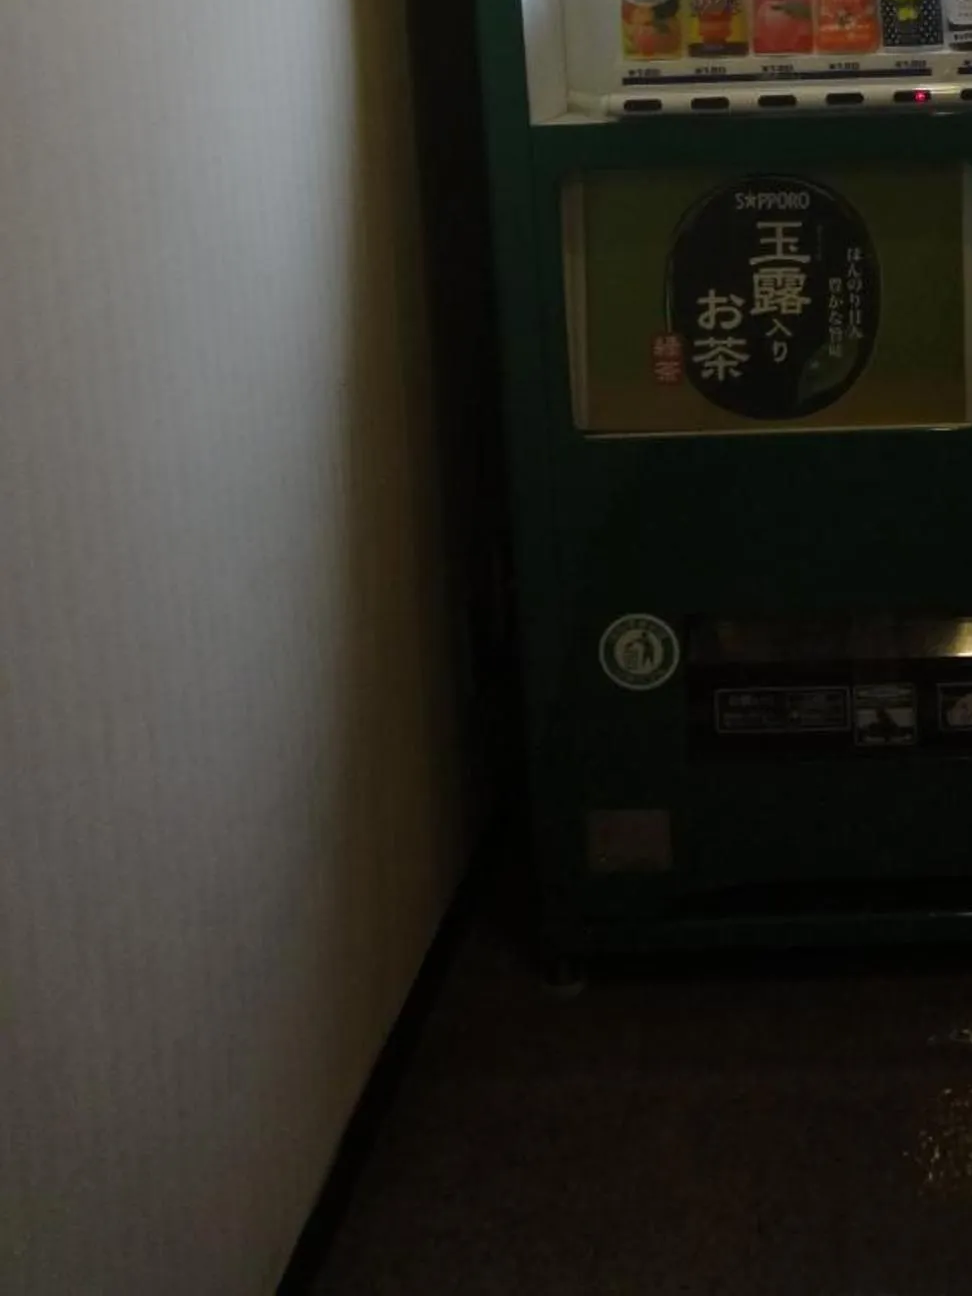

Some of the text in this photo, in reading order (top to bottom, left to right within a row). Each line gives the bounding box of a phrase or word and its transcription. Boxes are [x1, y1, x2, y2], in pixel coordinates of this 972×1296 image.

[692, 288, 750, 381] お茶
[750, 221, 812, 363] 玉露入り
